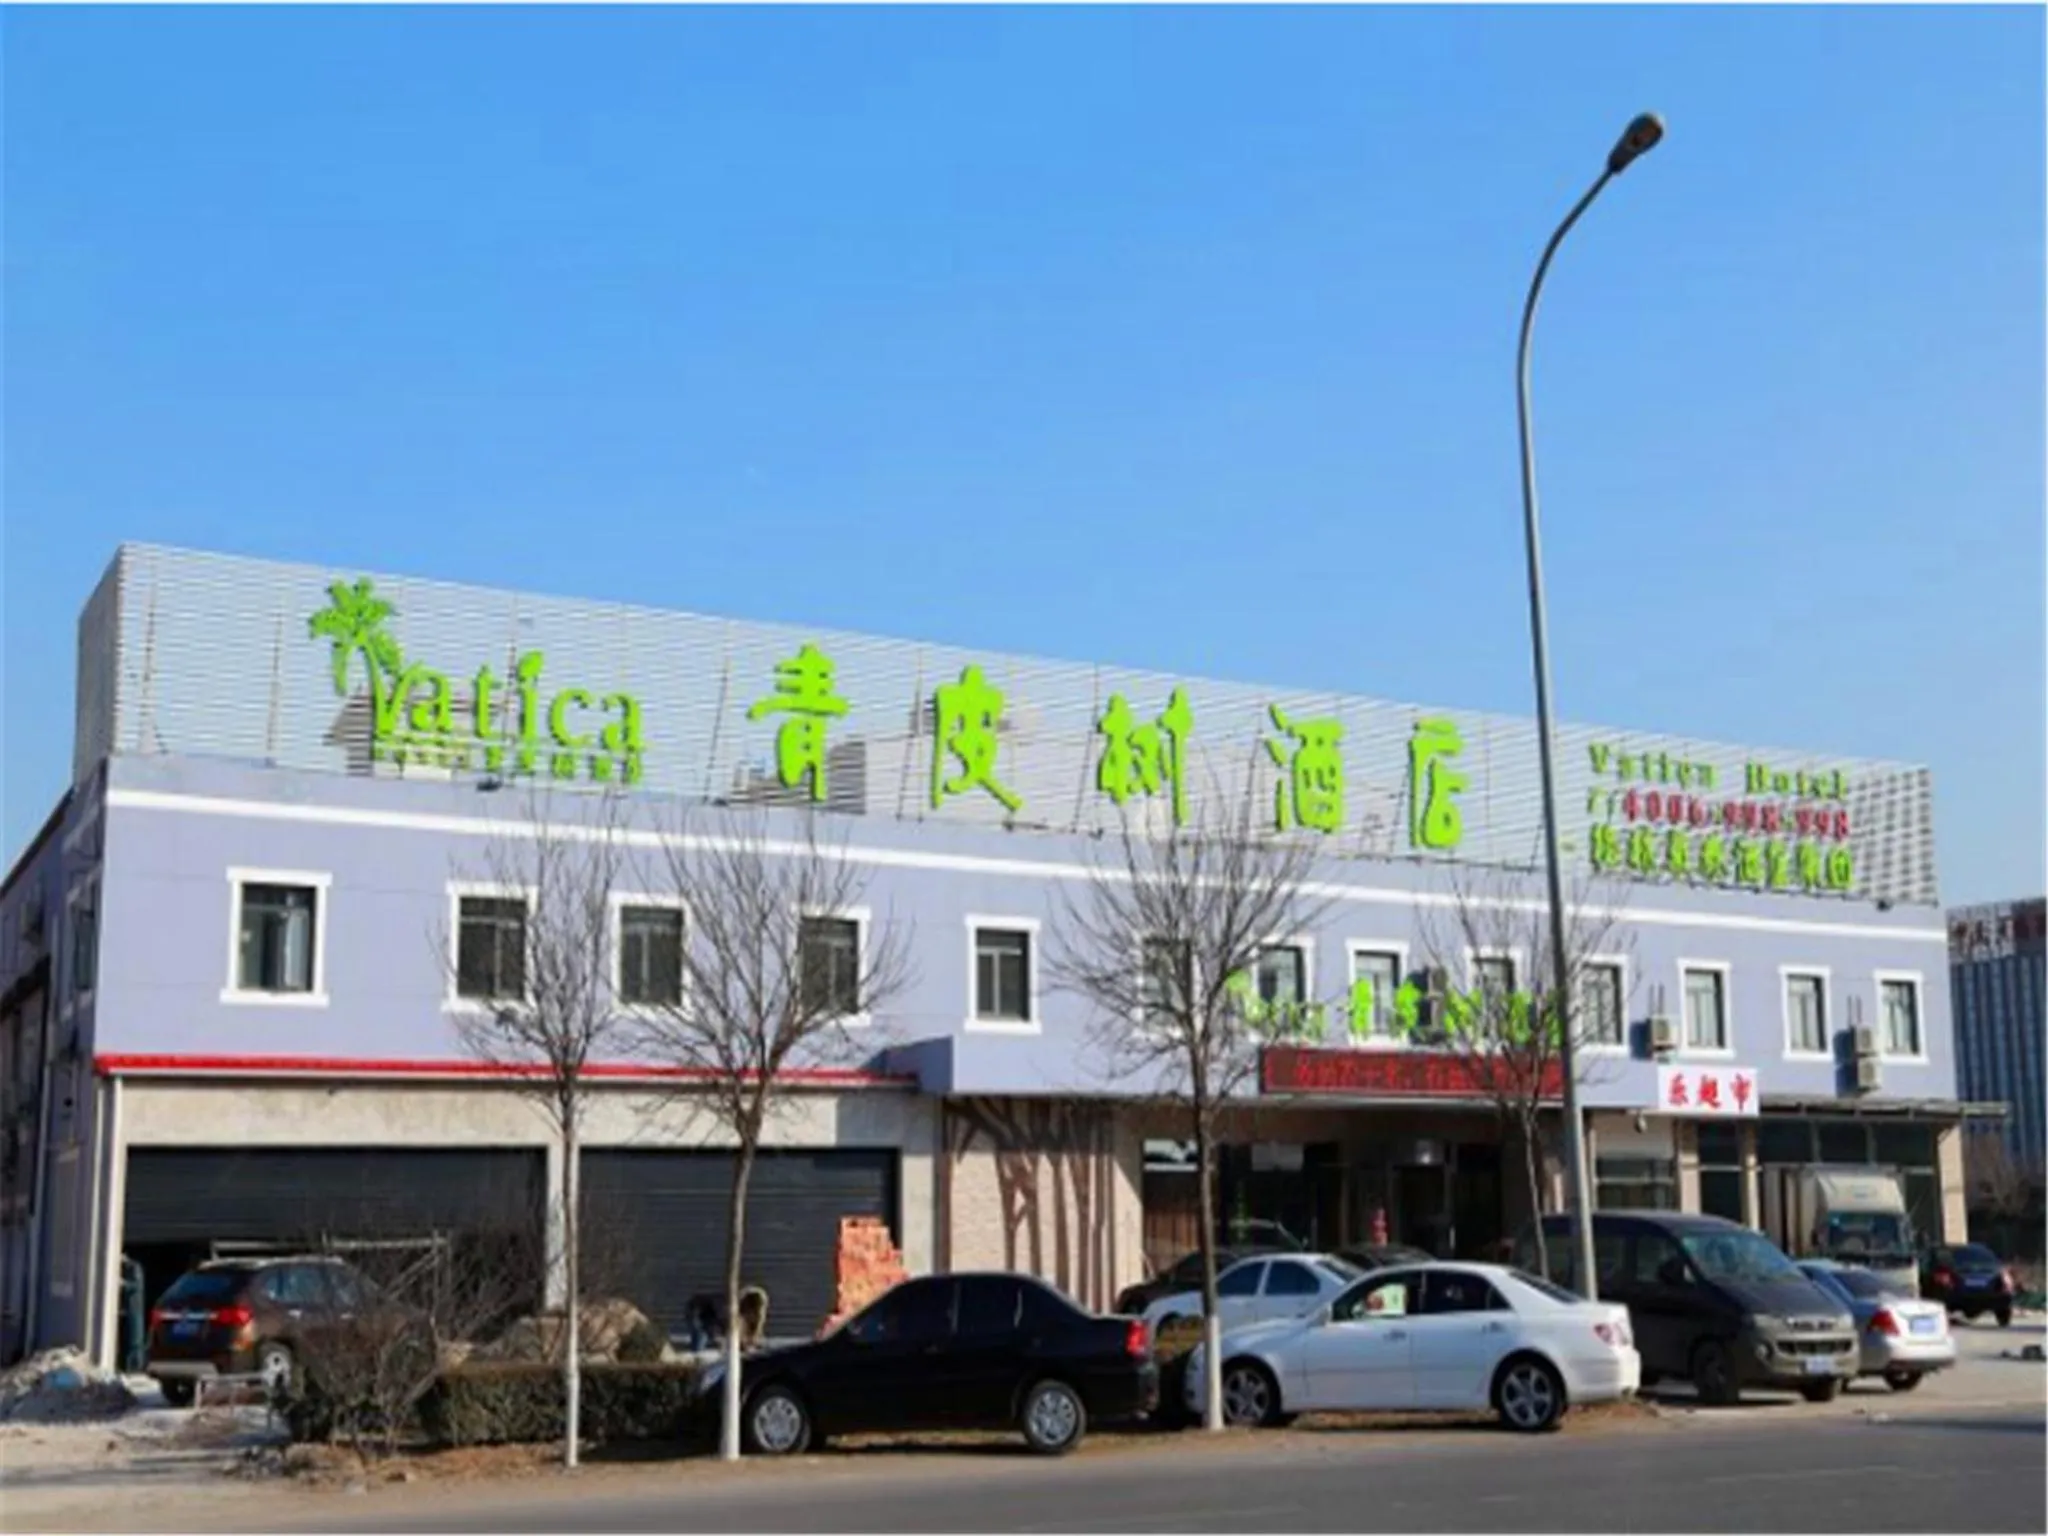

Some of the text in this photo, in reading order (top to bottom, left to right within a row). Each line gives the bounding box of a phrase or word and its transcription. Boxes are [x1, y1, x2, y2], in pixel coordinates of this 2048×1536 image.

[749, 643, 1466, 849] 青皮树酒店
